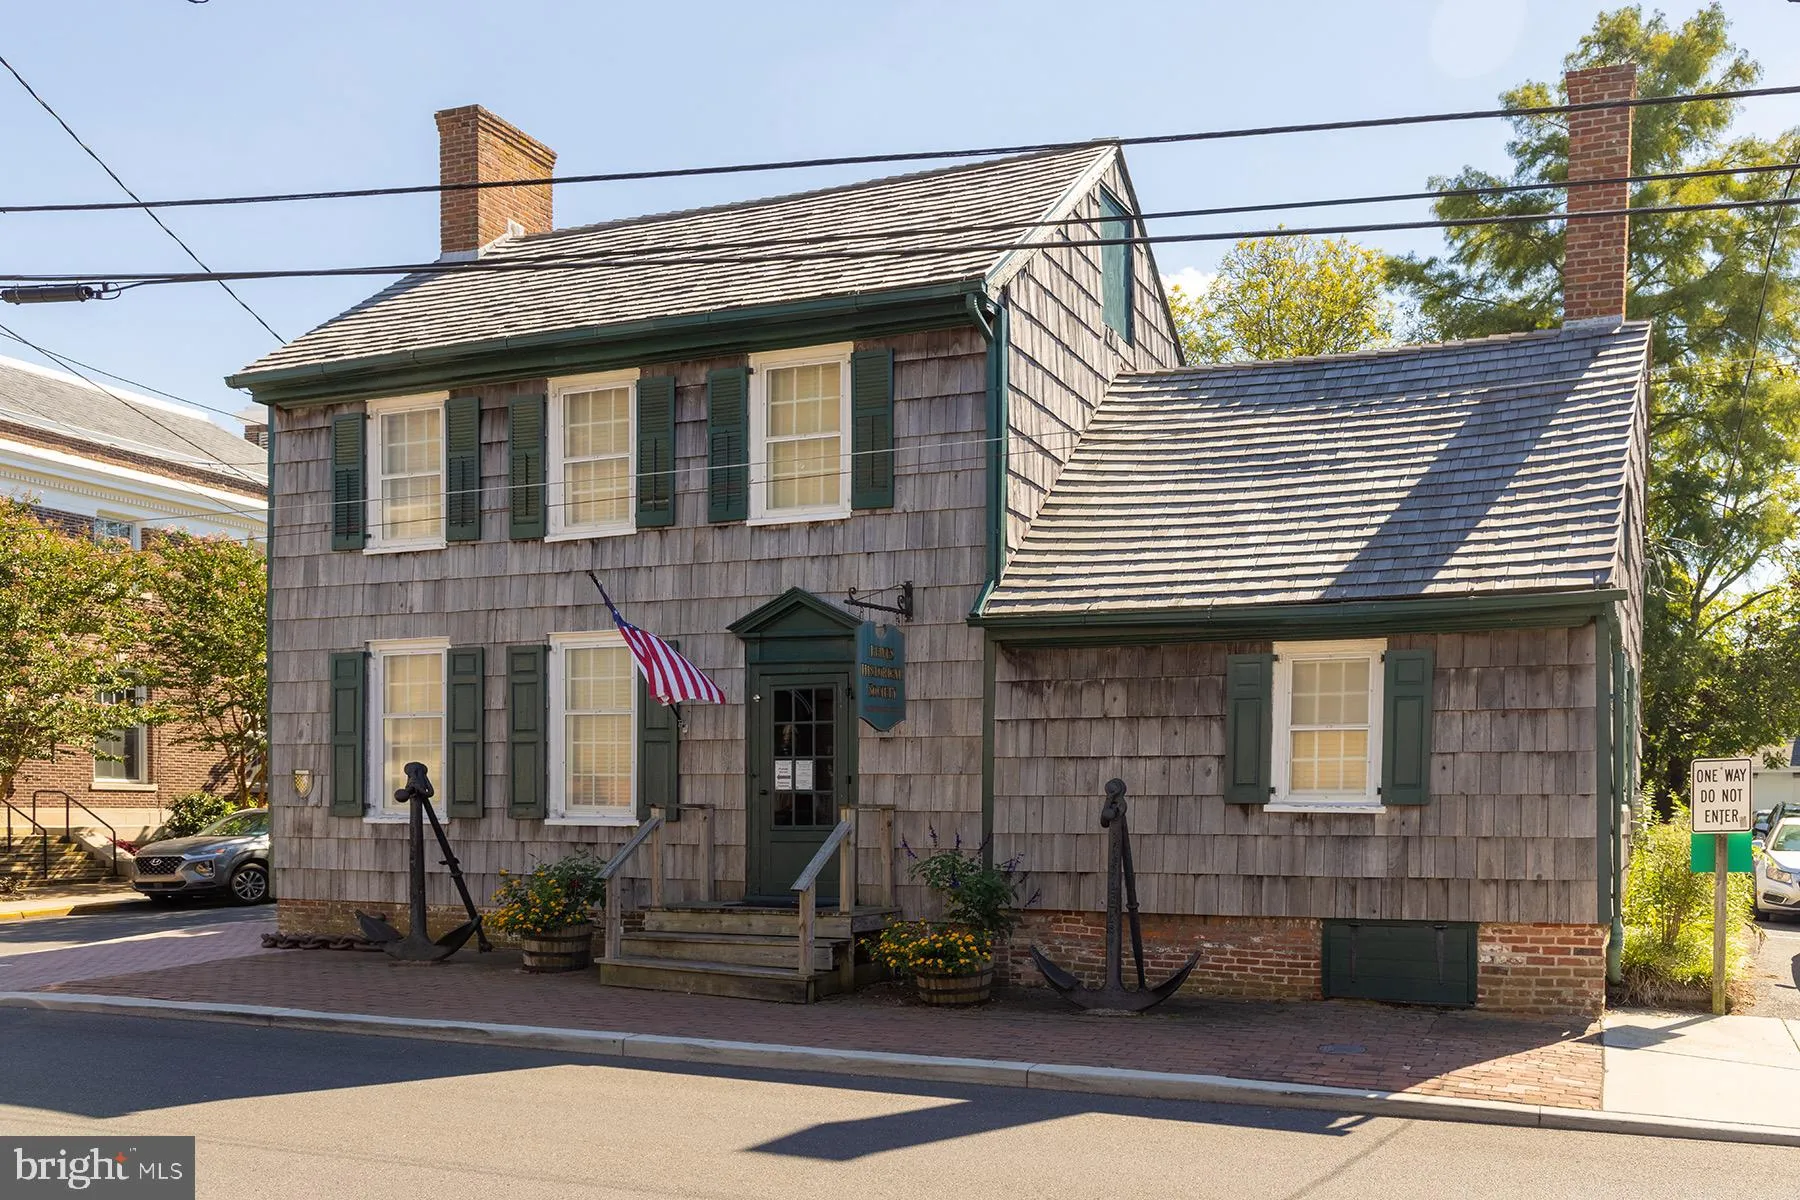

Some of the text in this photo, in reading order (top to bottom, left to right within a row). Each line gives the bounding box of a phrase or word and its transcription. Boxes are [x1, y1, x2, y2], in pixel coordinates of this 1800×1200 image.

[1697, 768, 1747, 783] ONE WAY
[1701, 788, 1743, 803] DO NOT
[1705, 809, 1739, 823] ENTER
